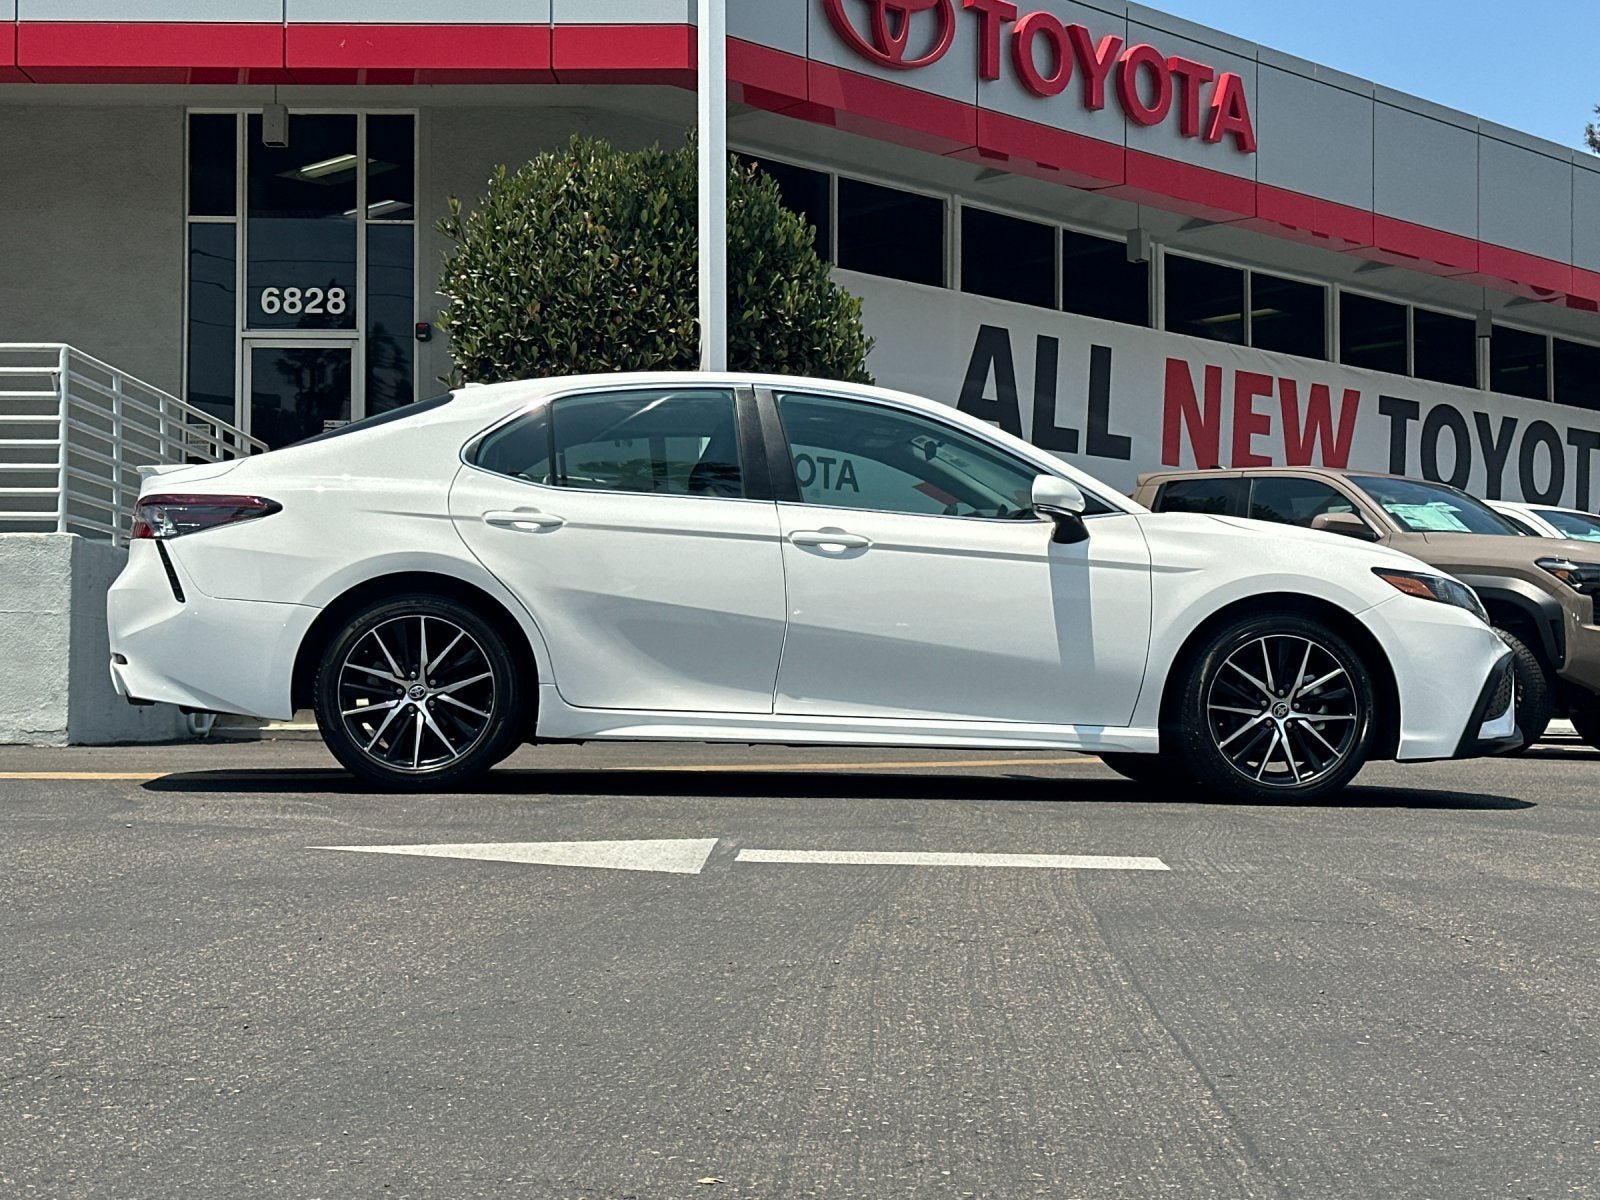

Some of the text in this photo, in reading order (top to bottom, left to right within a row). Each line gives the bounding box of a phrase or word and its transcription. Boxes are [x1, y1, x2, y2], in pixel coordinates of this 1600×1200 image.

[963, 0, 1257, 153] TOYOTA
[261, 287, 346, 314] 6828
[957, 324, 1600, 513] ALL NEW TOYOT
